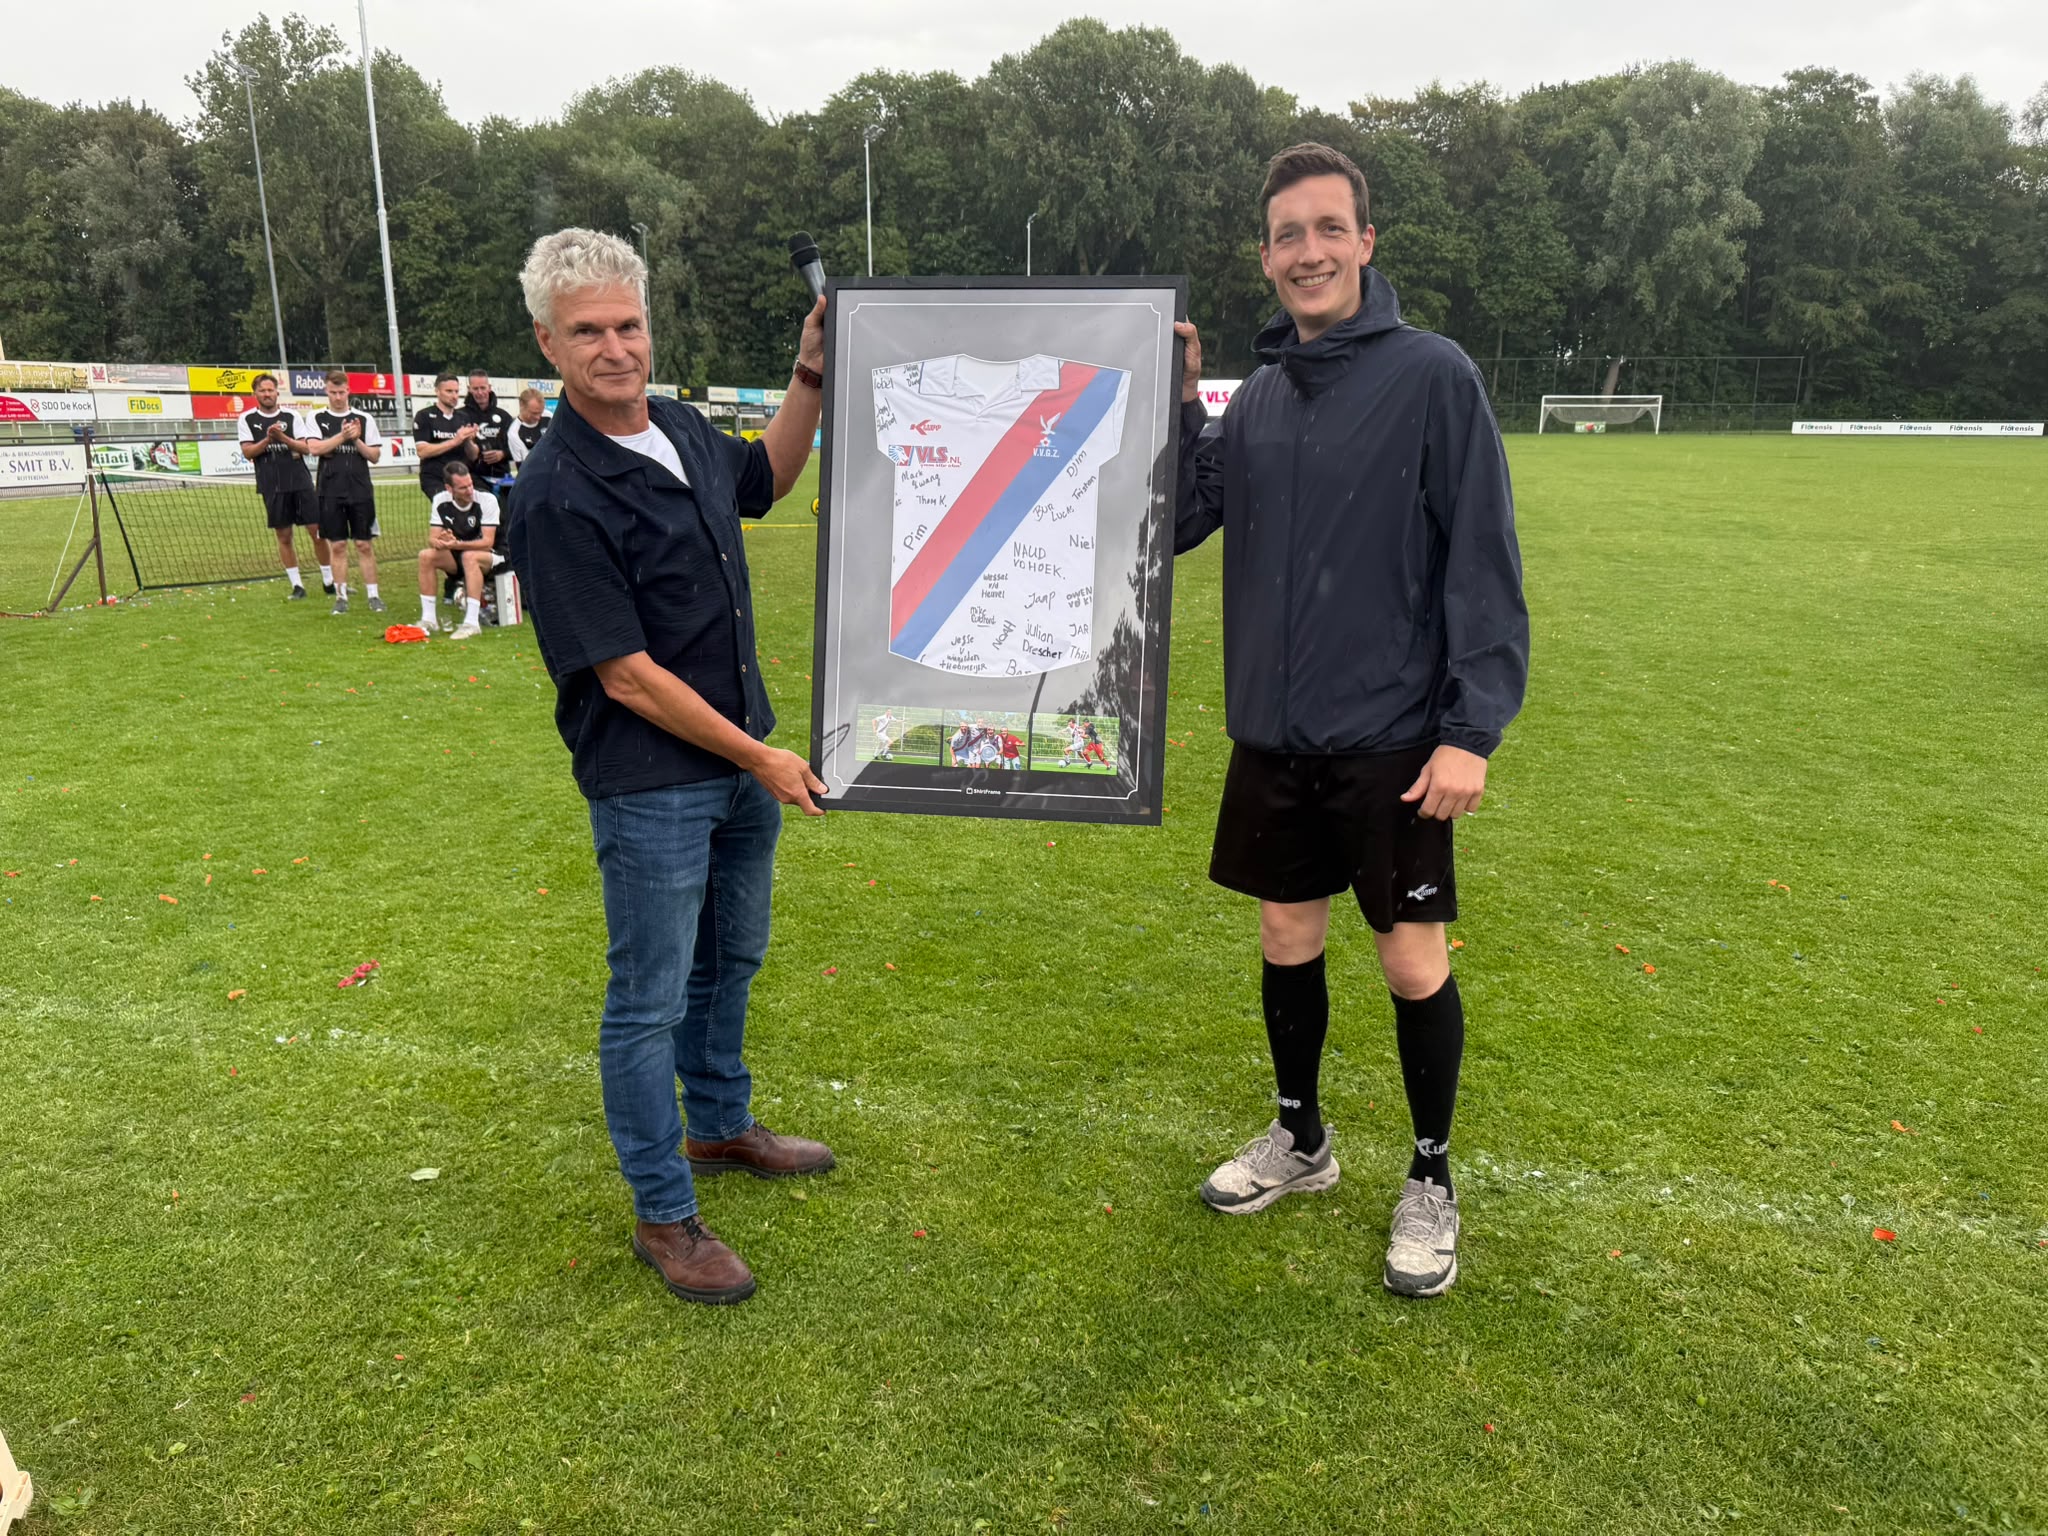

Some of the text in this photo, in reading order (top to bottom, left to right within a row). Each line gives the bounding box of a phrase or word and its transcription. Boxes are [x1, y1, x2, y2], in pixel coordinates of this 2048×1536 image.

[1206, 390, 1230, 403] VLS
[60, 401, 71, 410] De
[72, 401, 93, 410] Kock
[1800, 423, 2035, 432] Florensis Florensis Florensis Florensis Florensis
[9, 459, 43, 474] SMIT
[49, 458, 75, 472] B.V.
[1071, 475, 1097, 500] Tristan
[903, 523, 928, 551] Pim
[1013, 541, 1047, 560] NAUD
[1022, 638, 1063, 660] Drescher
